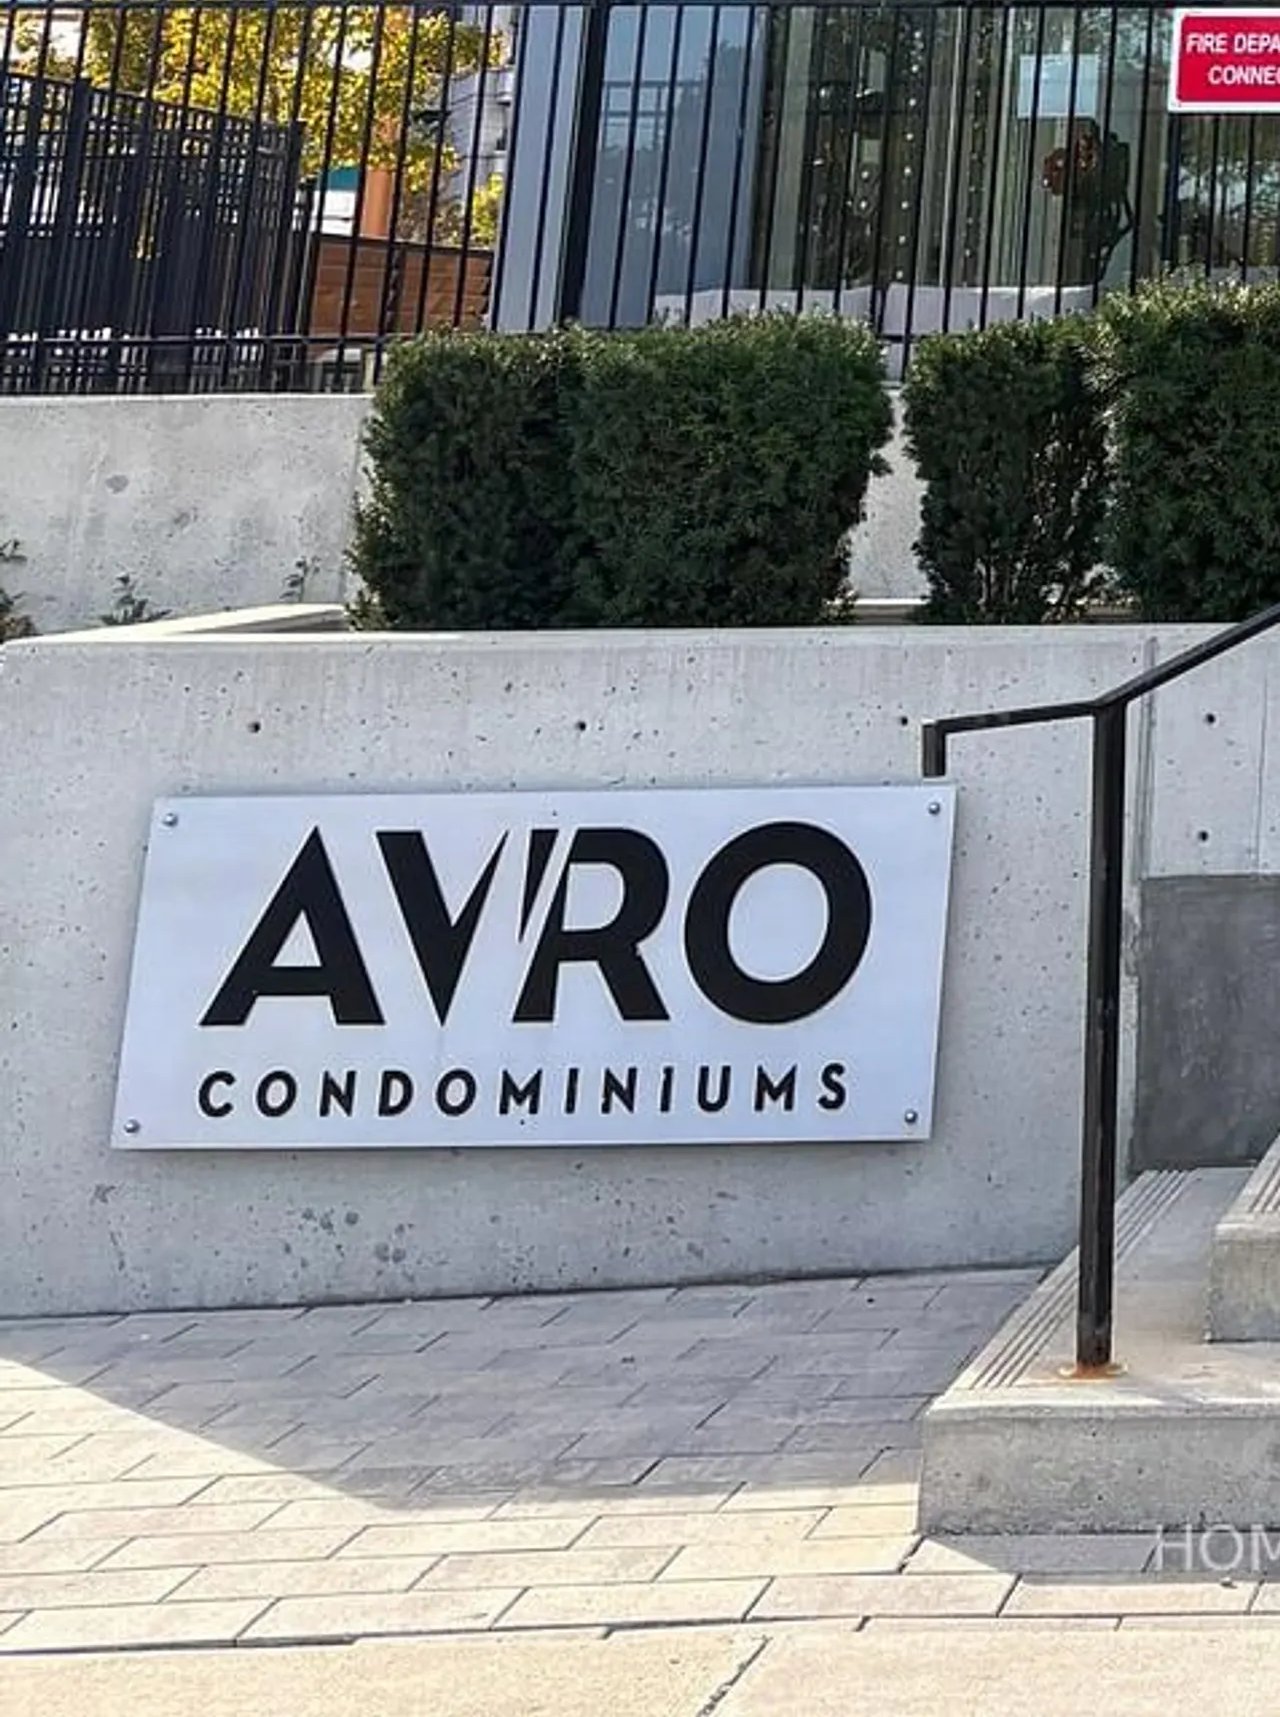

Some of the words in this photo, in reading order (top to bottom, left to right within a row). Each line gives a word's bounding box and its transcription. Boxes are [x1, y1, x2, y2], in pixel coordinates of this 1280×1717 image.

[1185, 32, 1229, 55] FIRE
[199, 820, 873, 1028] AVRO
[198, 1063, 850, 1118] CONDOMINIUMS
